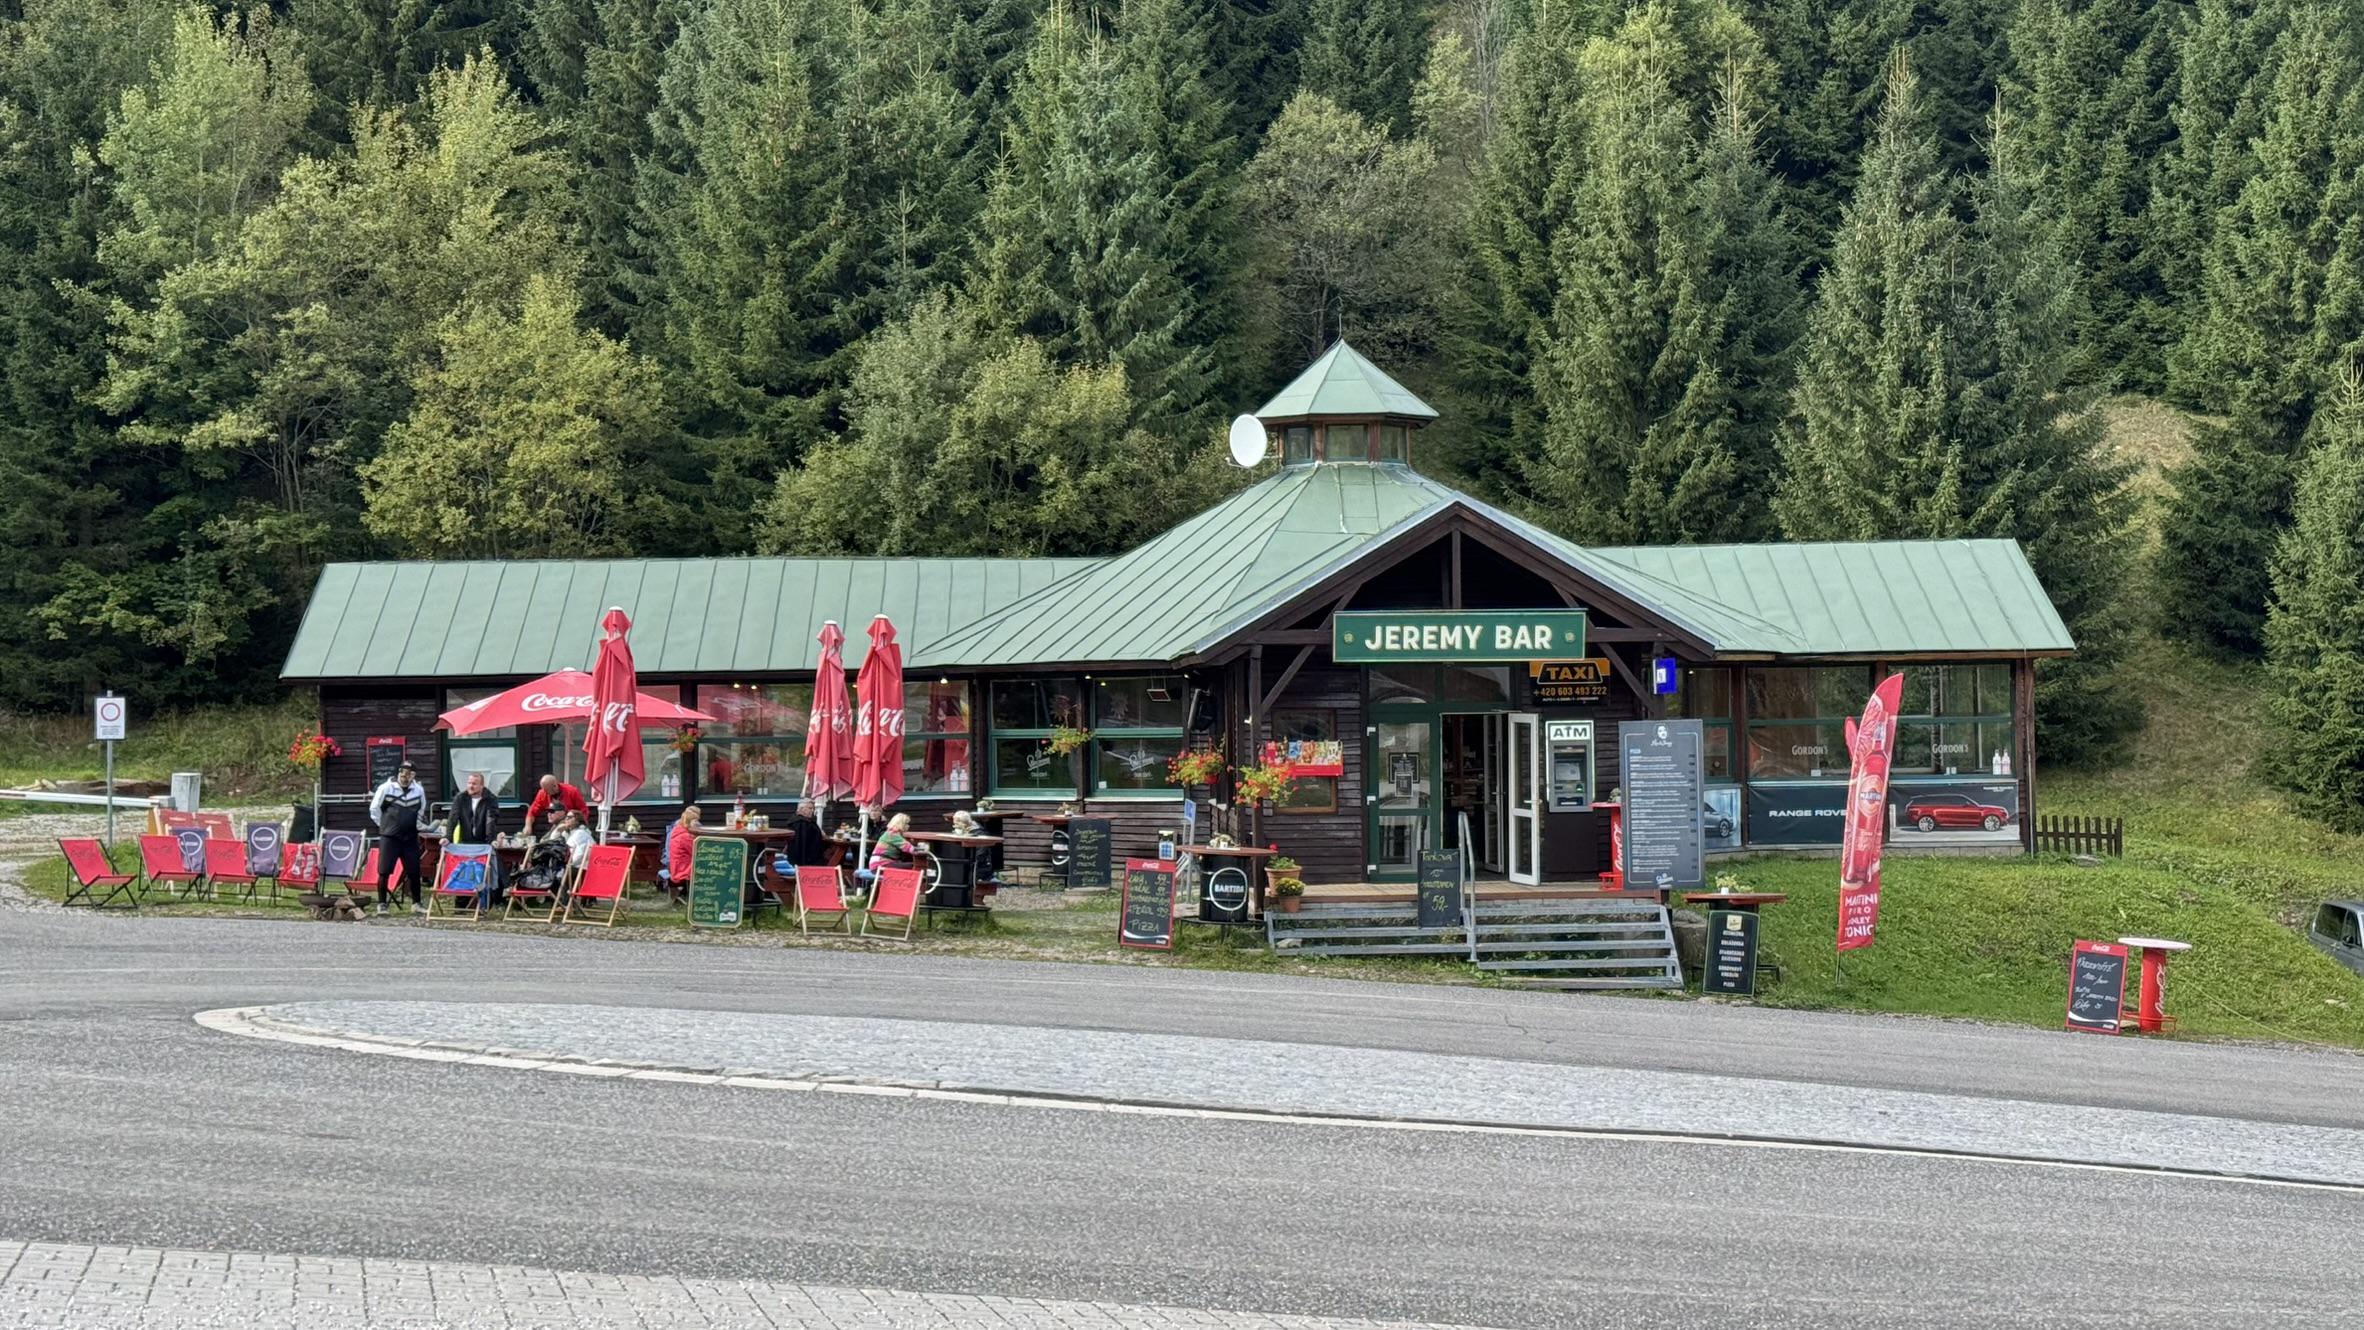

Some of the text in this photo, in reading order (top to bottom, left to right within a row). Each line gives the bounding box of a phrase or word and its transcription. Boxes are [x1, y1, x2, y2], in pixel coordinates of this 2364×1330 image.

[1364, 624, 1553, 650] JEREMY BAR
[1546, 666, 1594, 680] TAXI
[1533, 687, 1556, 697] +420
[1591, 686, 1607, 695] 222
[521, 692, 595, 712] Coca-C
[1553, 726, 1588, 737] ATM
[1768, 808, 1848, 818] RANGE ROVE
[1129, 919, 1160, 934] PIZZA
